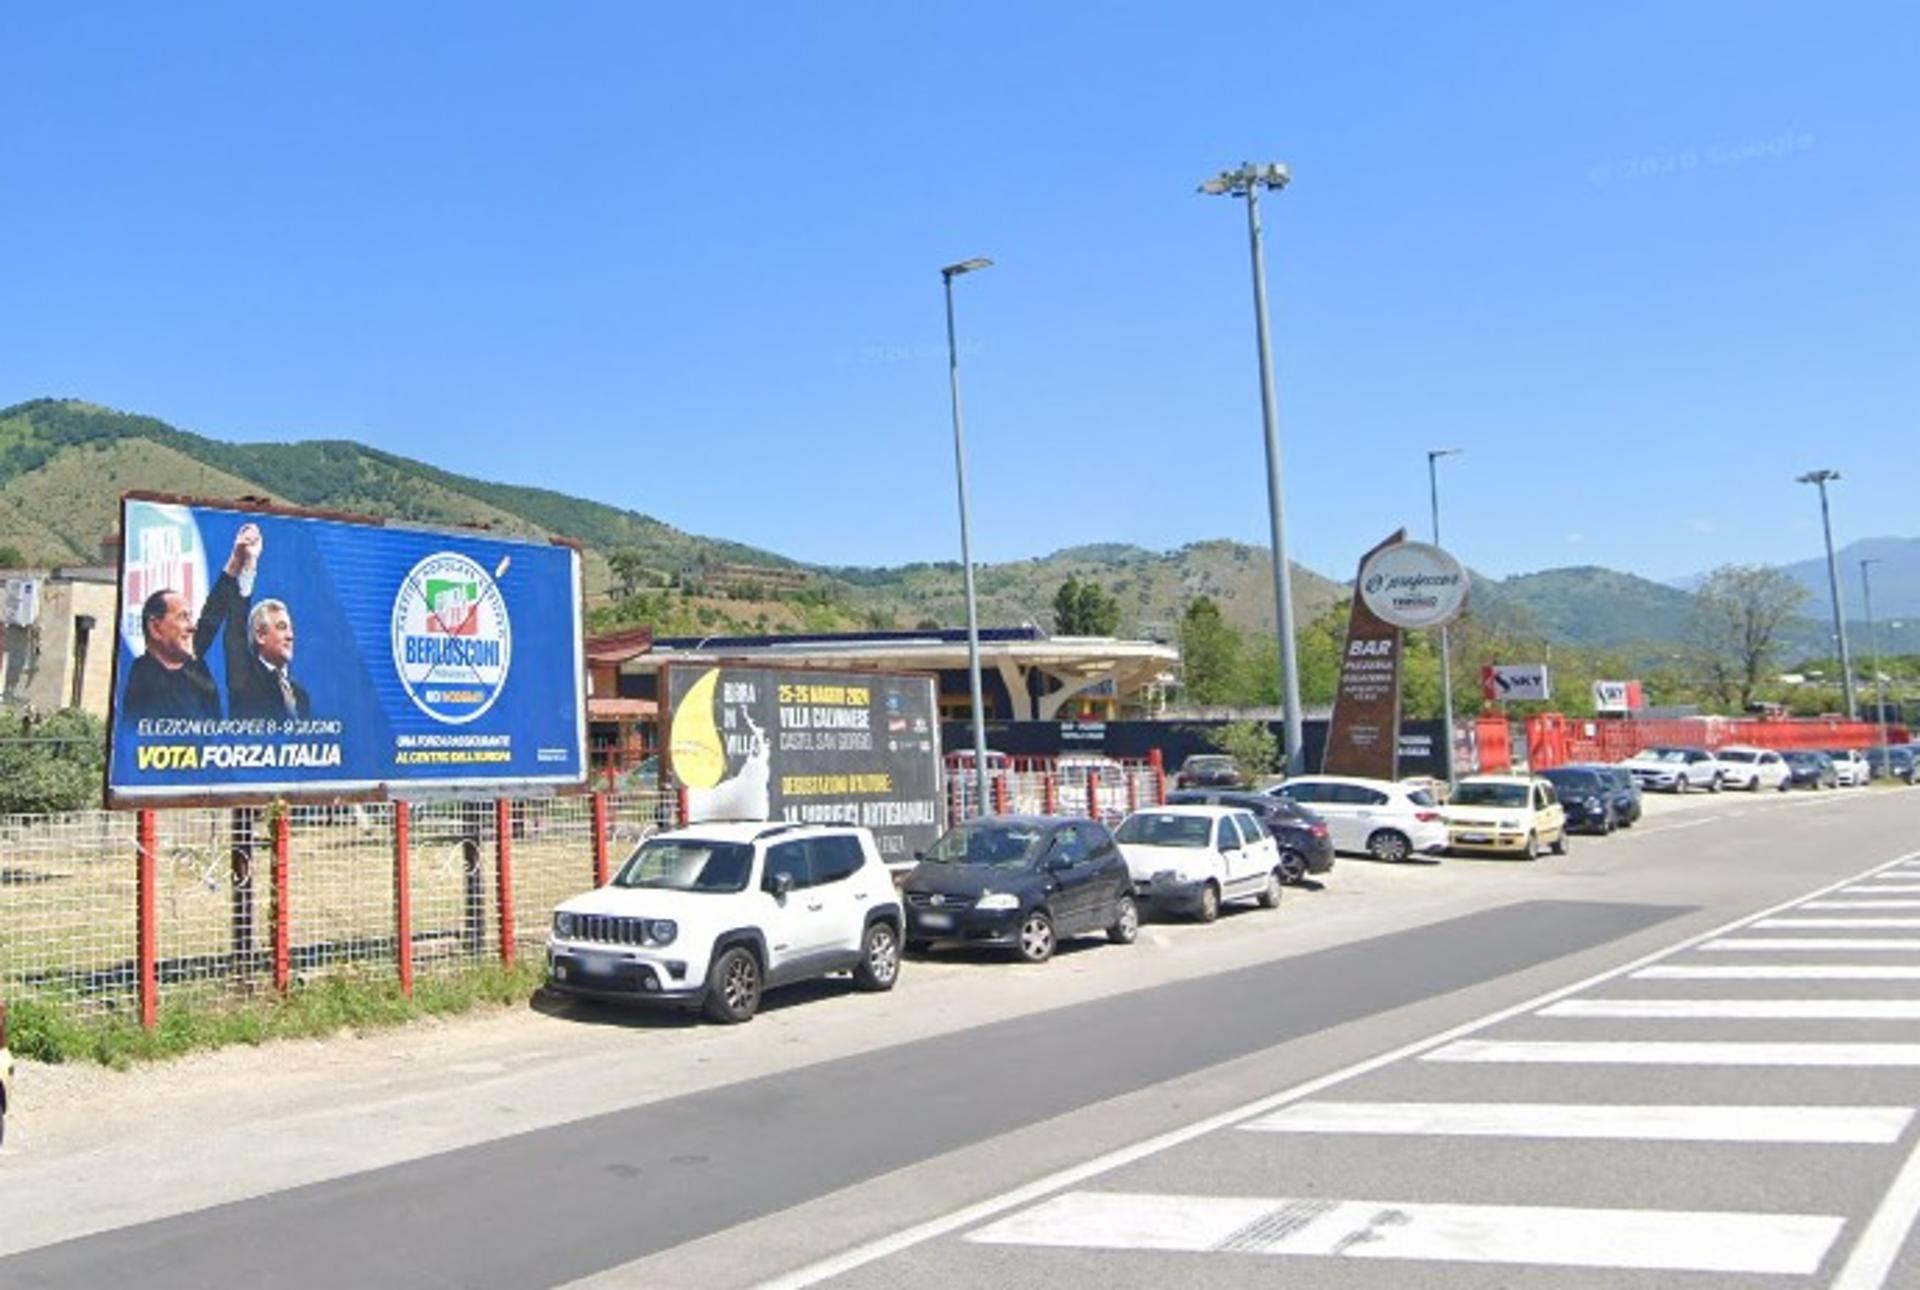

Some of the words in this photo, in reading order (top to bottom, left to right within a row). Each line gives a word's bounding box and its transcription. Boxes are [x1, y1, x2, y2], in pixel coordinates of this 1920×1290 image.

[406, 636, 500, 667] BERLUSCONI
[1348, 640, 1392, 656] BAR
[1510, 675, 1543, 687] SKY
[138, 718, 200, 736] ELEZIONI
[202, 718, 265, 736] EUROPEE
[294, 719, 342, 736] GIUGNO
[723, 707, 737, 729] IN
[780, 706, 810, 730] VILLA
[779, 732, 815, 751] CASTEL
[816, 732, 837, 751] SAN
[137, 745, 199, 770] VOTA
[200, 744, 276, 769] FORZA
[278, 742, 342, 767] ITALIA
[863, 800, 935, 827] ARTIGIANALI
